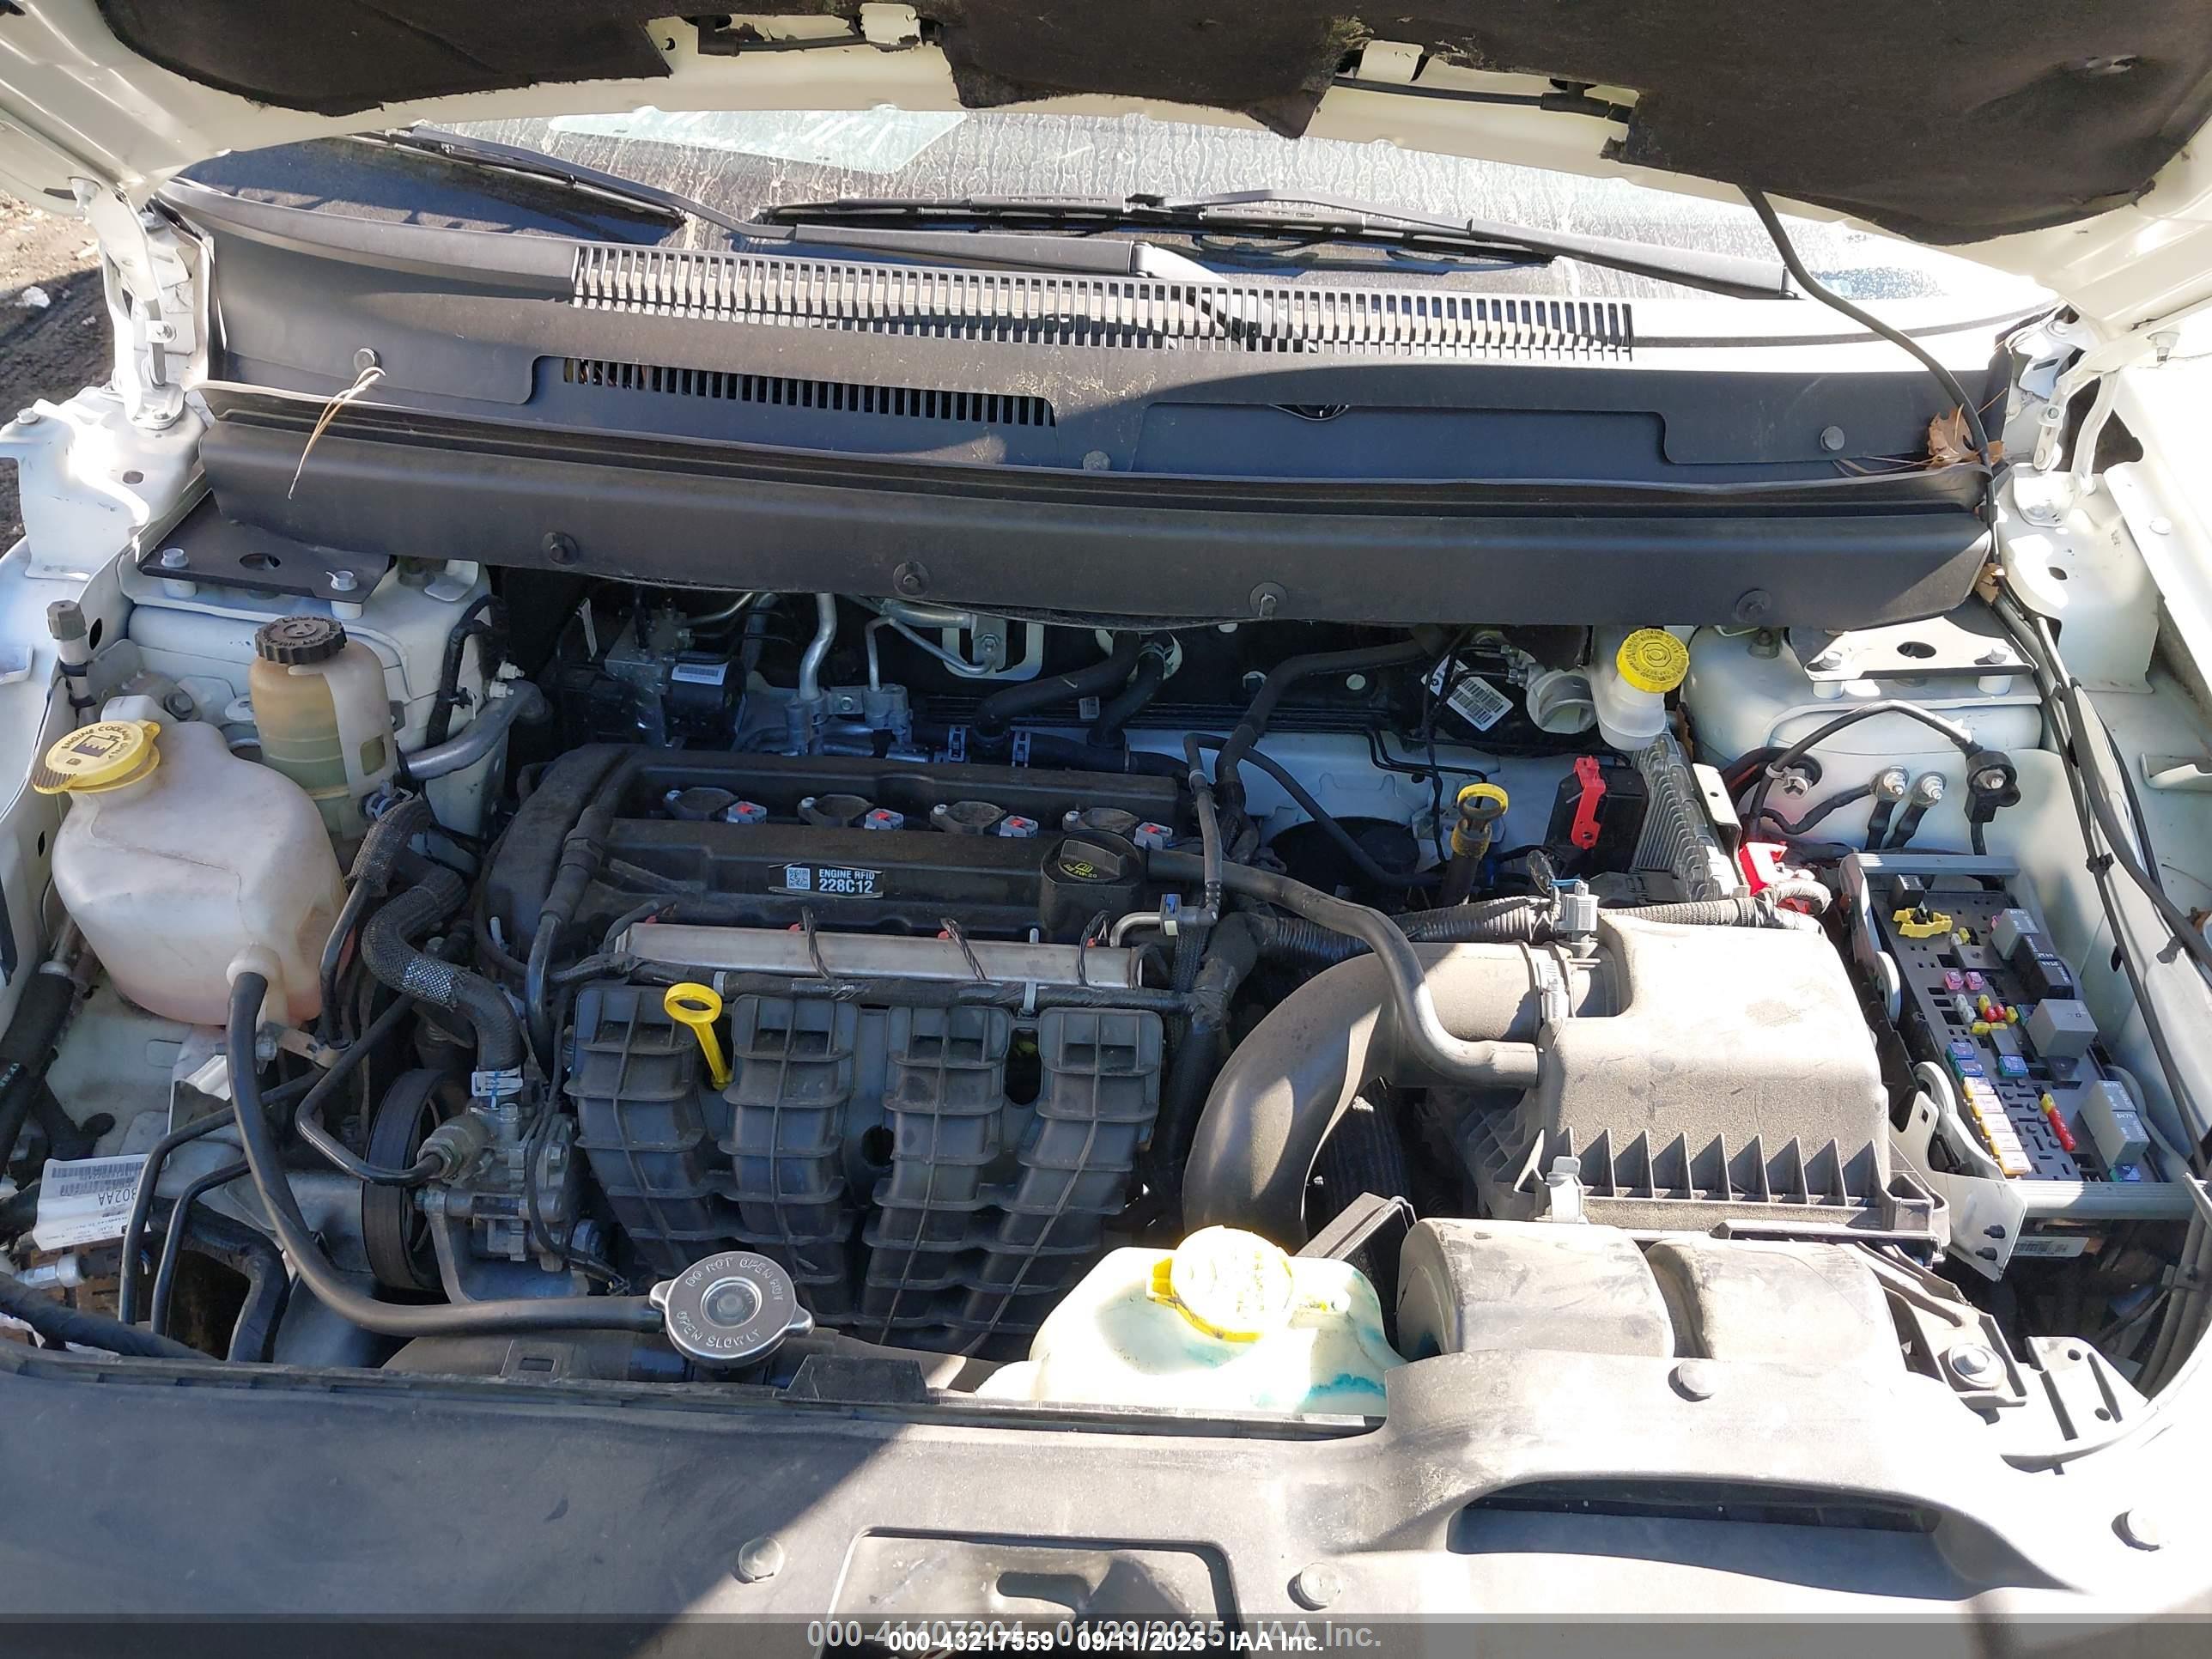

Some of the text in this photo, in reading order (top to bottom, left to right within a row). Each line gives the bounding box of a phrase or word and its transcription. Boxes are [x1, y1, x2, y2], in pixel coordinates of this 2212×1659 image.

[61, 728, 95, 750] ENGINE
[818, 868, 876, 880] ENGINE RFID
[818, 878, 874, 894] 228C12
[685, 1270, 702, 1287] DO
[706, 1256, 733, 1273] NOT
[739, 1257, 773, 1279] OPEN
[770, 1278, 784, 1302] HOT
[677, 1310, 762, 1349] OPEN SLOWLY
